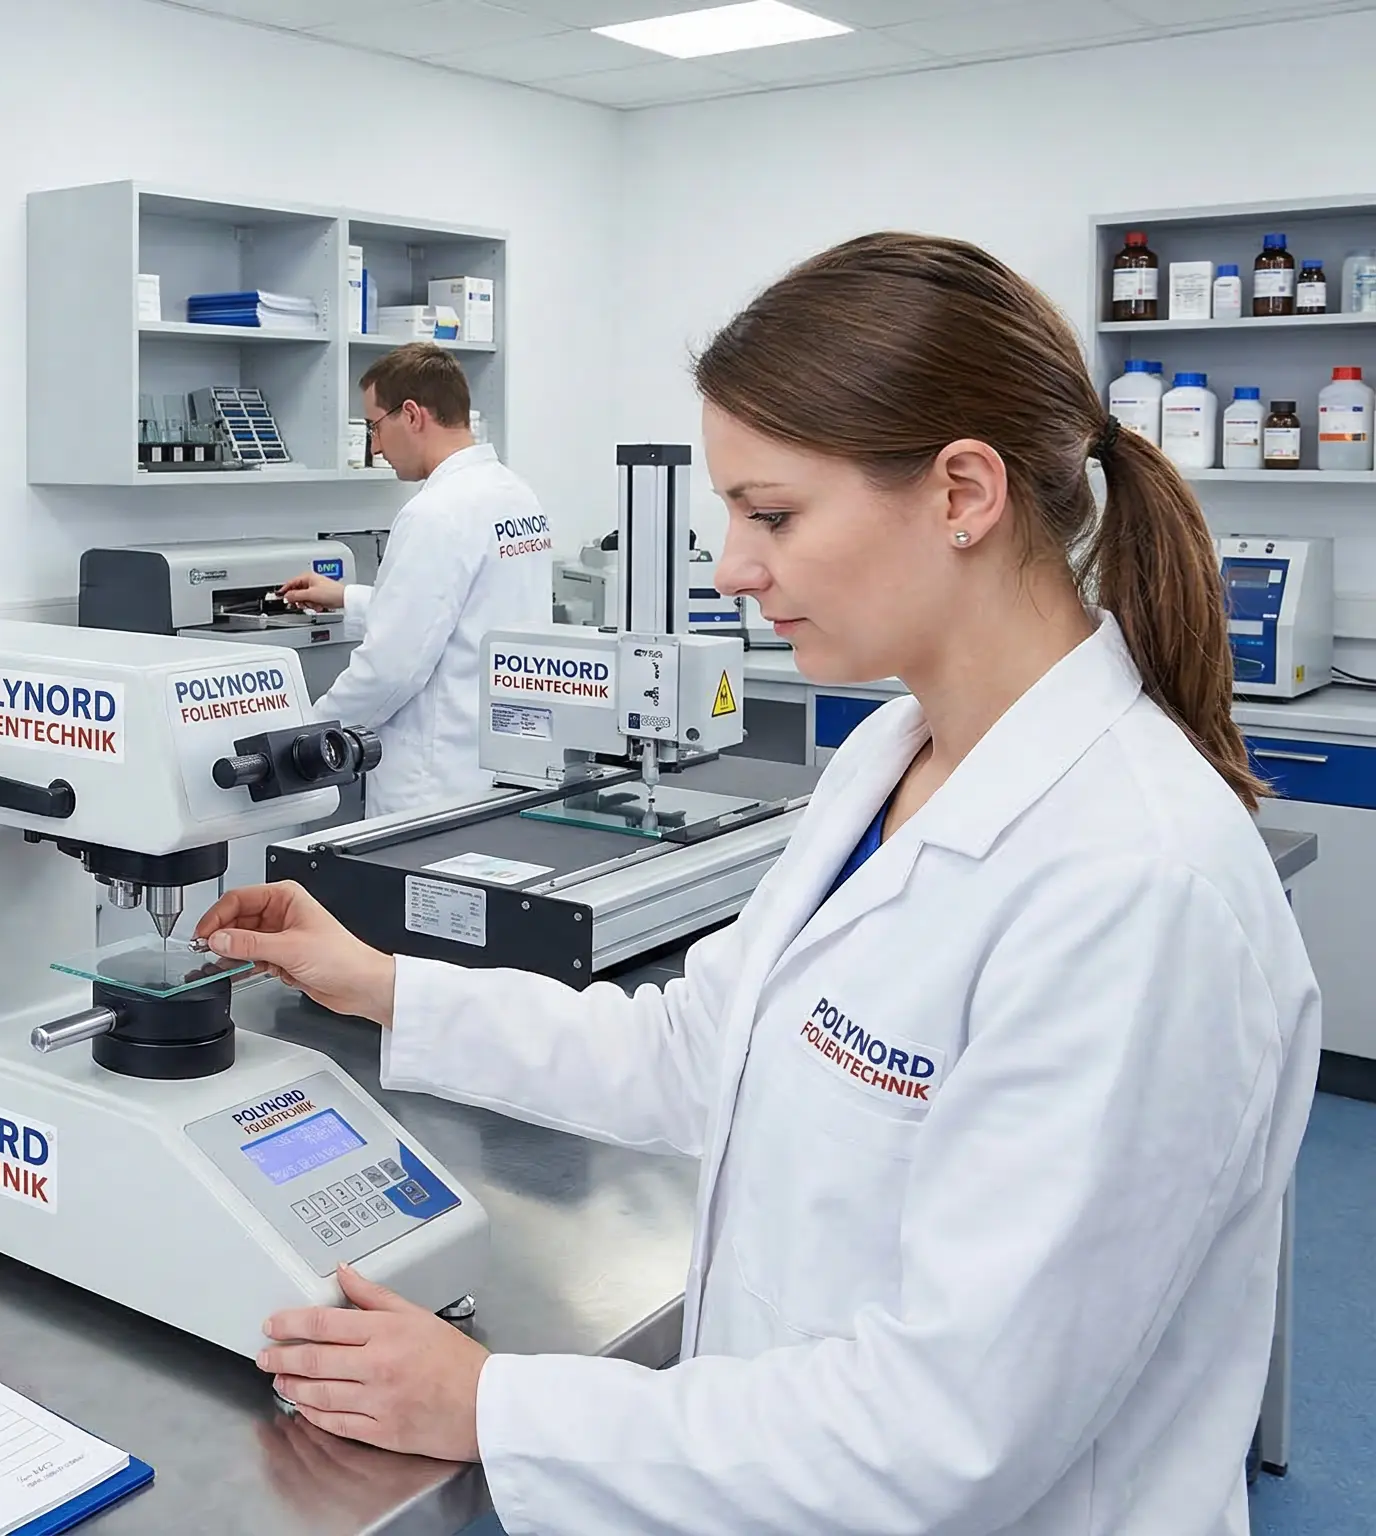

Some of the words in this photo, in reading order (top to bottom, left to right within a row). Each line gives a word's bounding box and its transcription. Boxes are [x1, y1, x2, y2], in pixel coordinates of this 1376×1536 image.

[493, 653, 609, 681] POLYNORD
[174, 668, 285, 704] POLYNORD
[493, 674, 609, 699] FOLIENTECHNIK
[181, 692, 290, 725] FOLIENTECHNIK
[811, 997, 935, 1079] POLYNORD
[800, 1021, 932, 1101] FOLIENTECHNIK
[231, 1089, 306, 1126] POLYNORD
